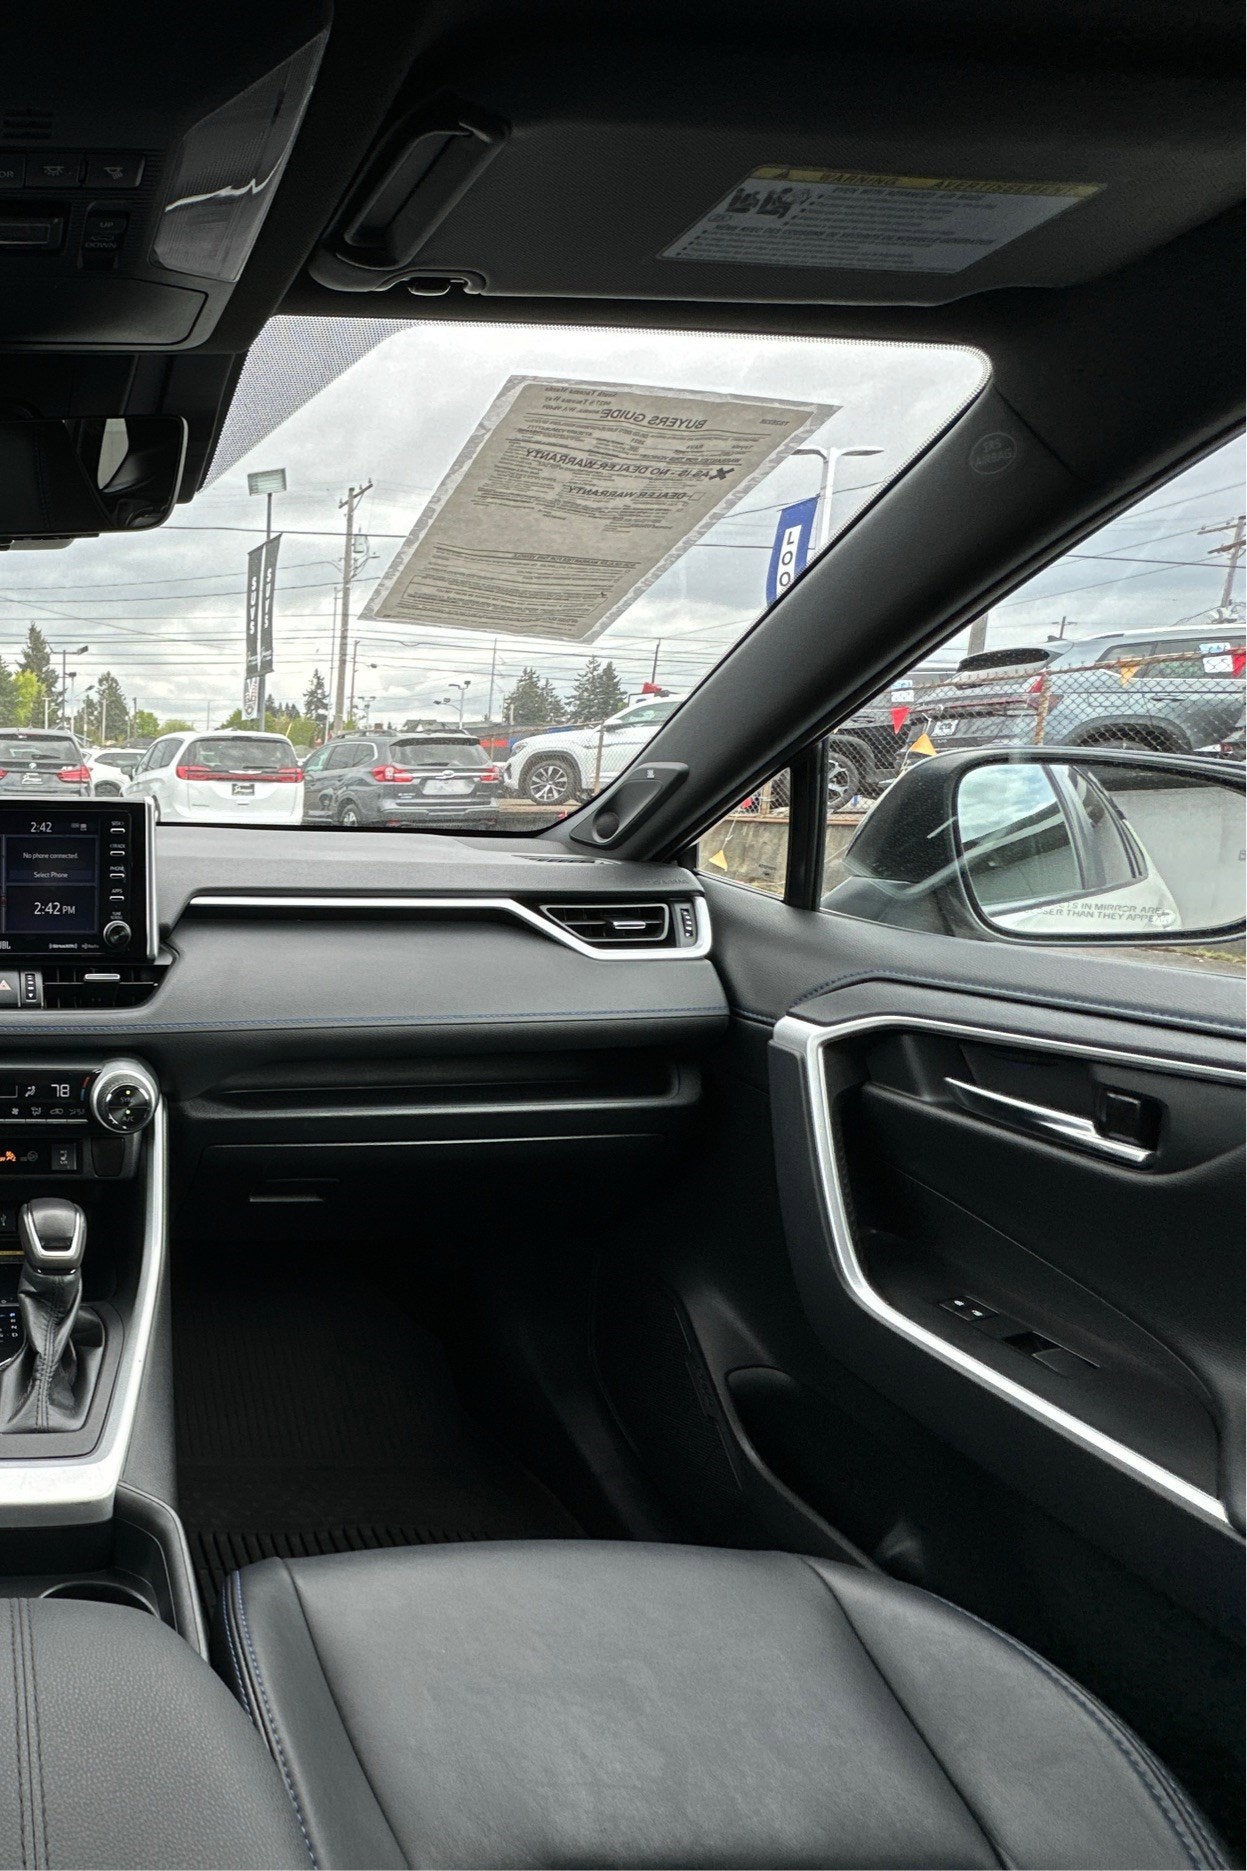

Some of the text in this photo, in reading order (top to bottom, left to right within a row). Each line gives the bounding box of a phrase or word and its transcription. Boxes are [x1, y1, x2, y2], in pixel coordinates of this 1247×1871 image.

[30, 821, 52, 832] 2:42
[34, 901, 76, 915] 2:42 PM
[1094, 903, 1138, 913] MIRROR
[1067, 909, 1094, 918] THAN
[1097, 911, 1124, 920] THEY
[51, 1084, 70, 1097] 78
